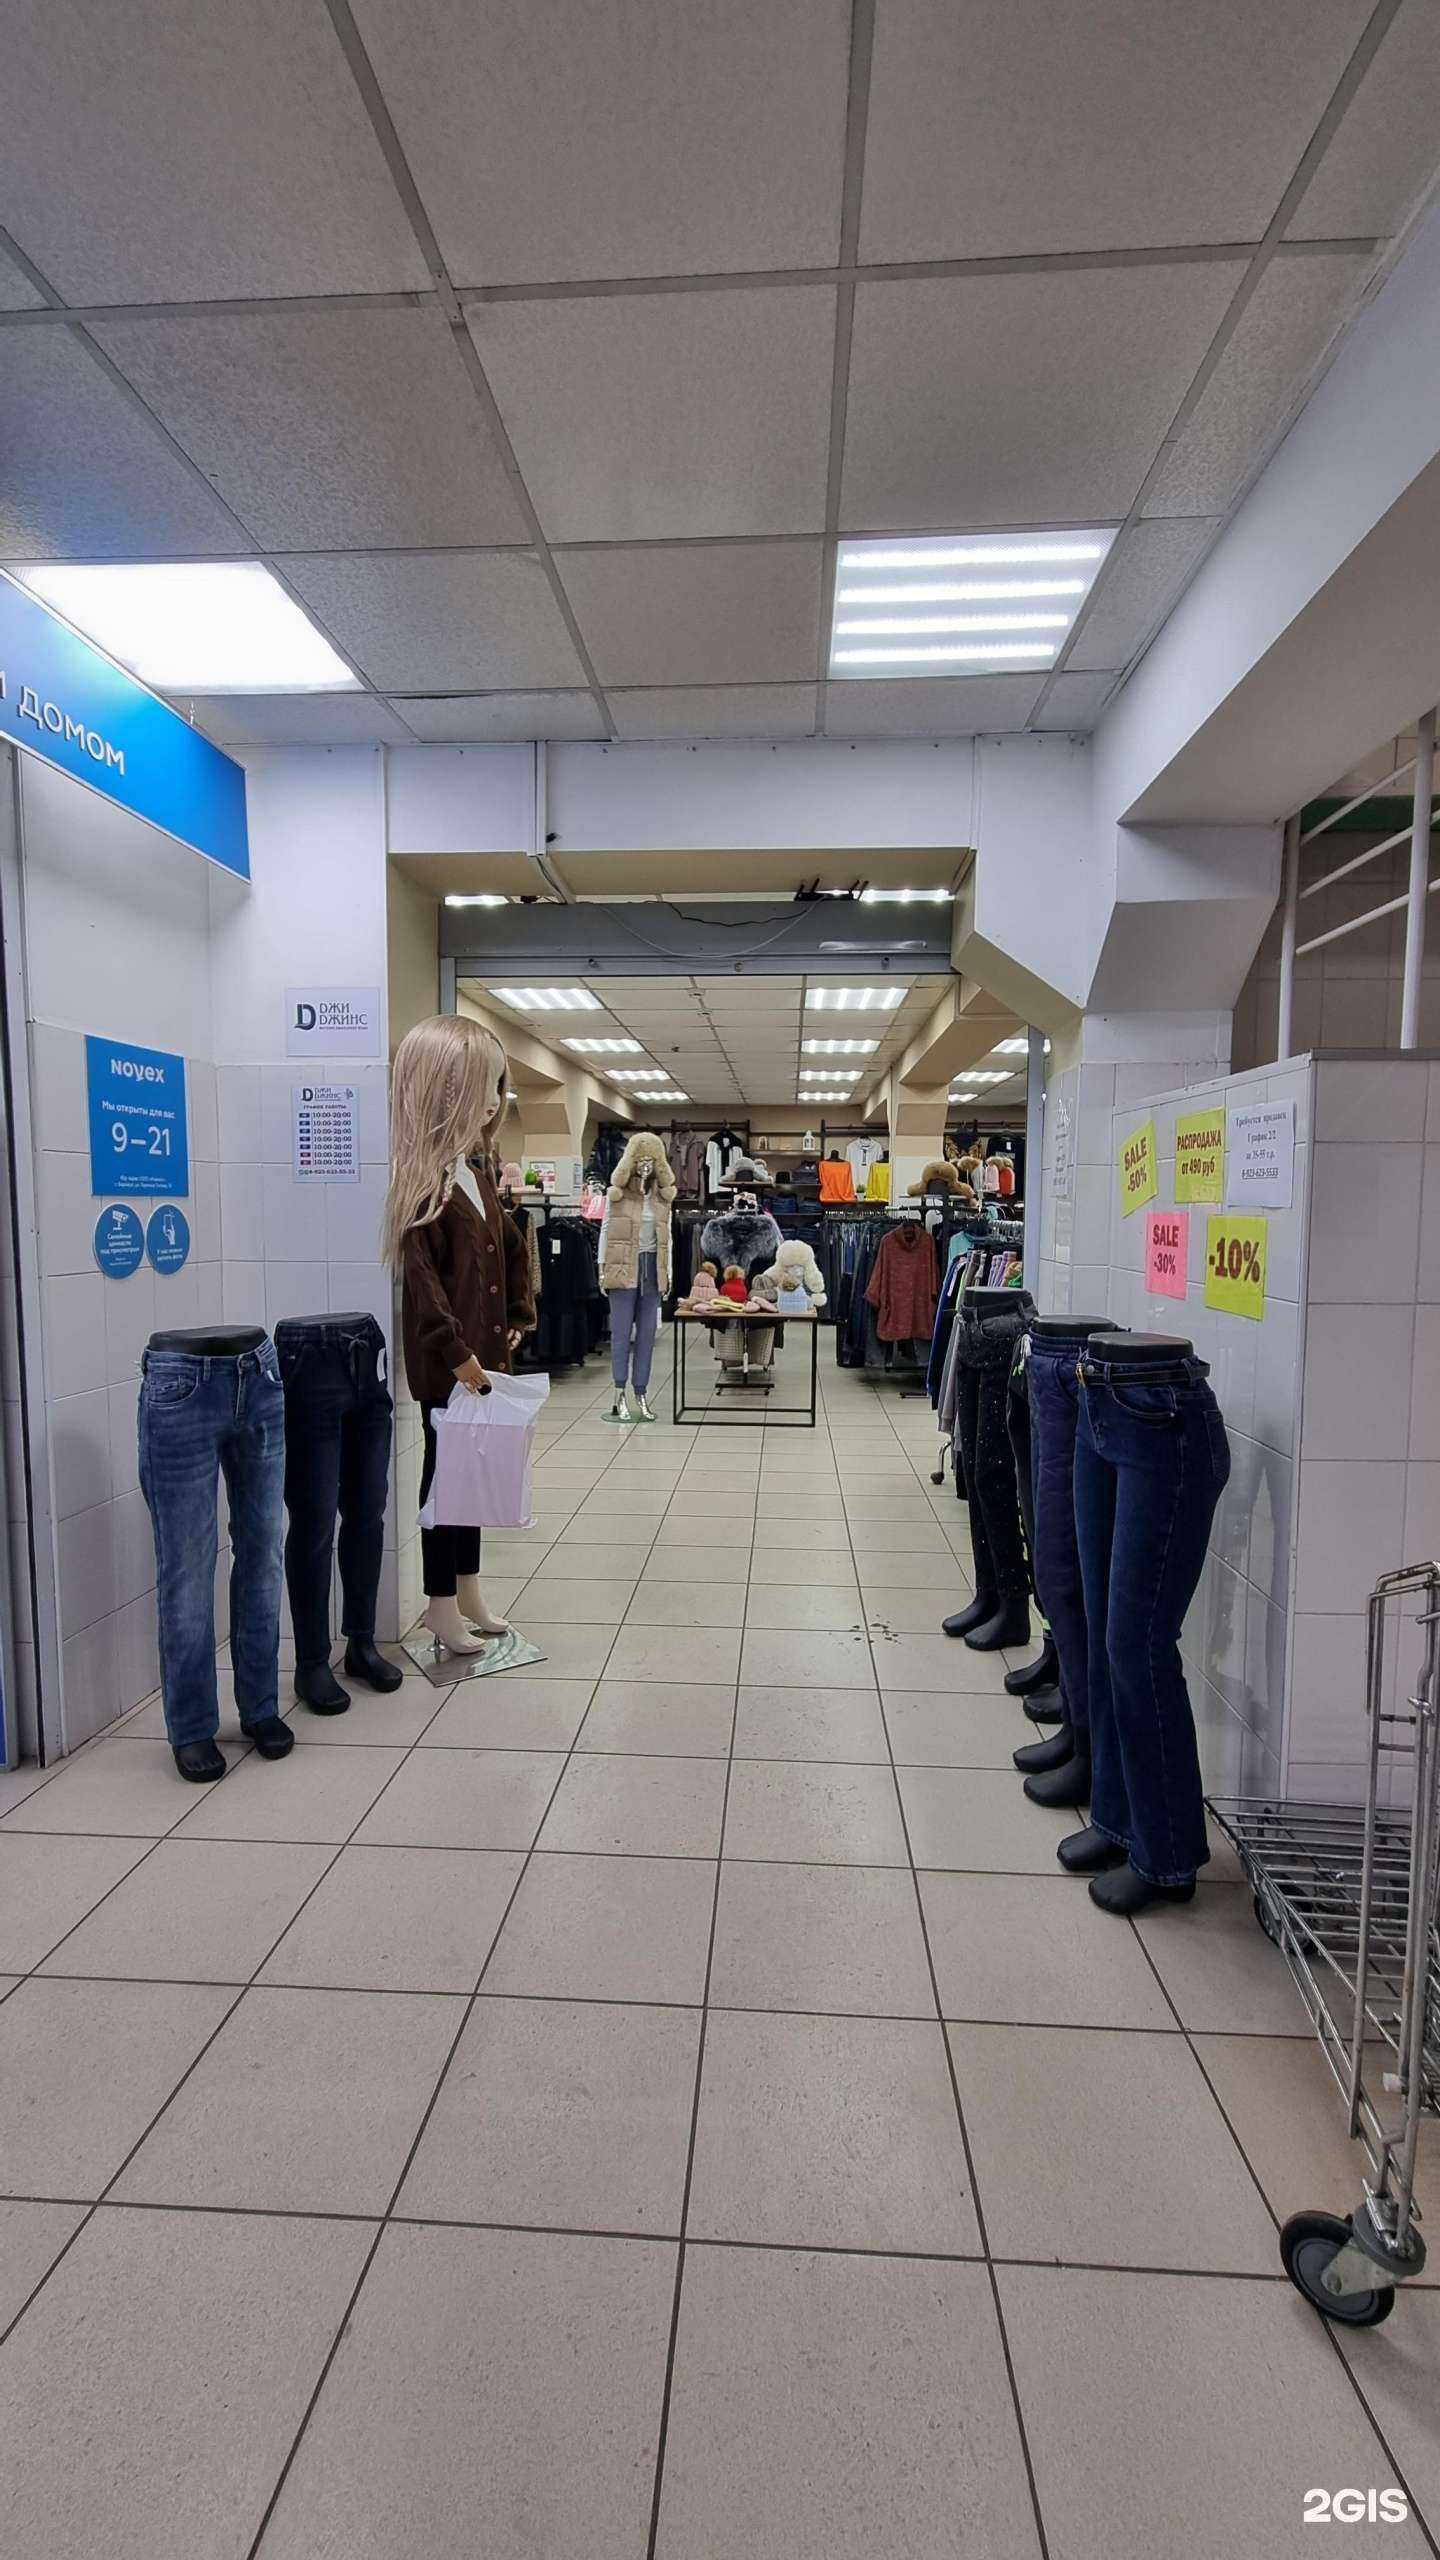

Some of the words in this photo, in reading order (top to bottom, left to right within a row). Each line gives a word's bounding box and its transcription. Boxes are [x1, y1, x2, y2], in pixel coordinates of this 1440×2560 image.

[101, 1100, 115, 1111] Мы
[116, 1103, 149, 1115] открыты
[149, 1108, 162, 1117] для
[163, 1110, 176, 1119] вас
[1176, 1129, 1222, 1152] РАСПРОДАЖА
[1124, 1136, 1147, 1171] SALE
[1127, 1164, 1147, 1192] -50%
[1181, 1162, 1189, 1175] от
[1189, 1158, 1202, 1174] 490
[1202, 1156, 1215, 1177] руб
[1152, 1224, 1180, 1247] SALE
[1153, 1252, 1176, 1275] -30%
[1208, 1237, 1260, 1283] -10%
